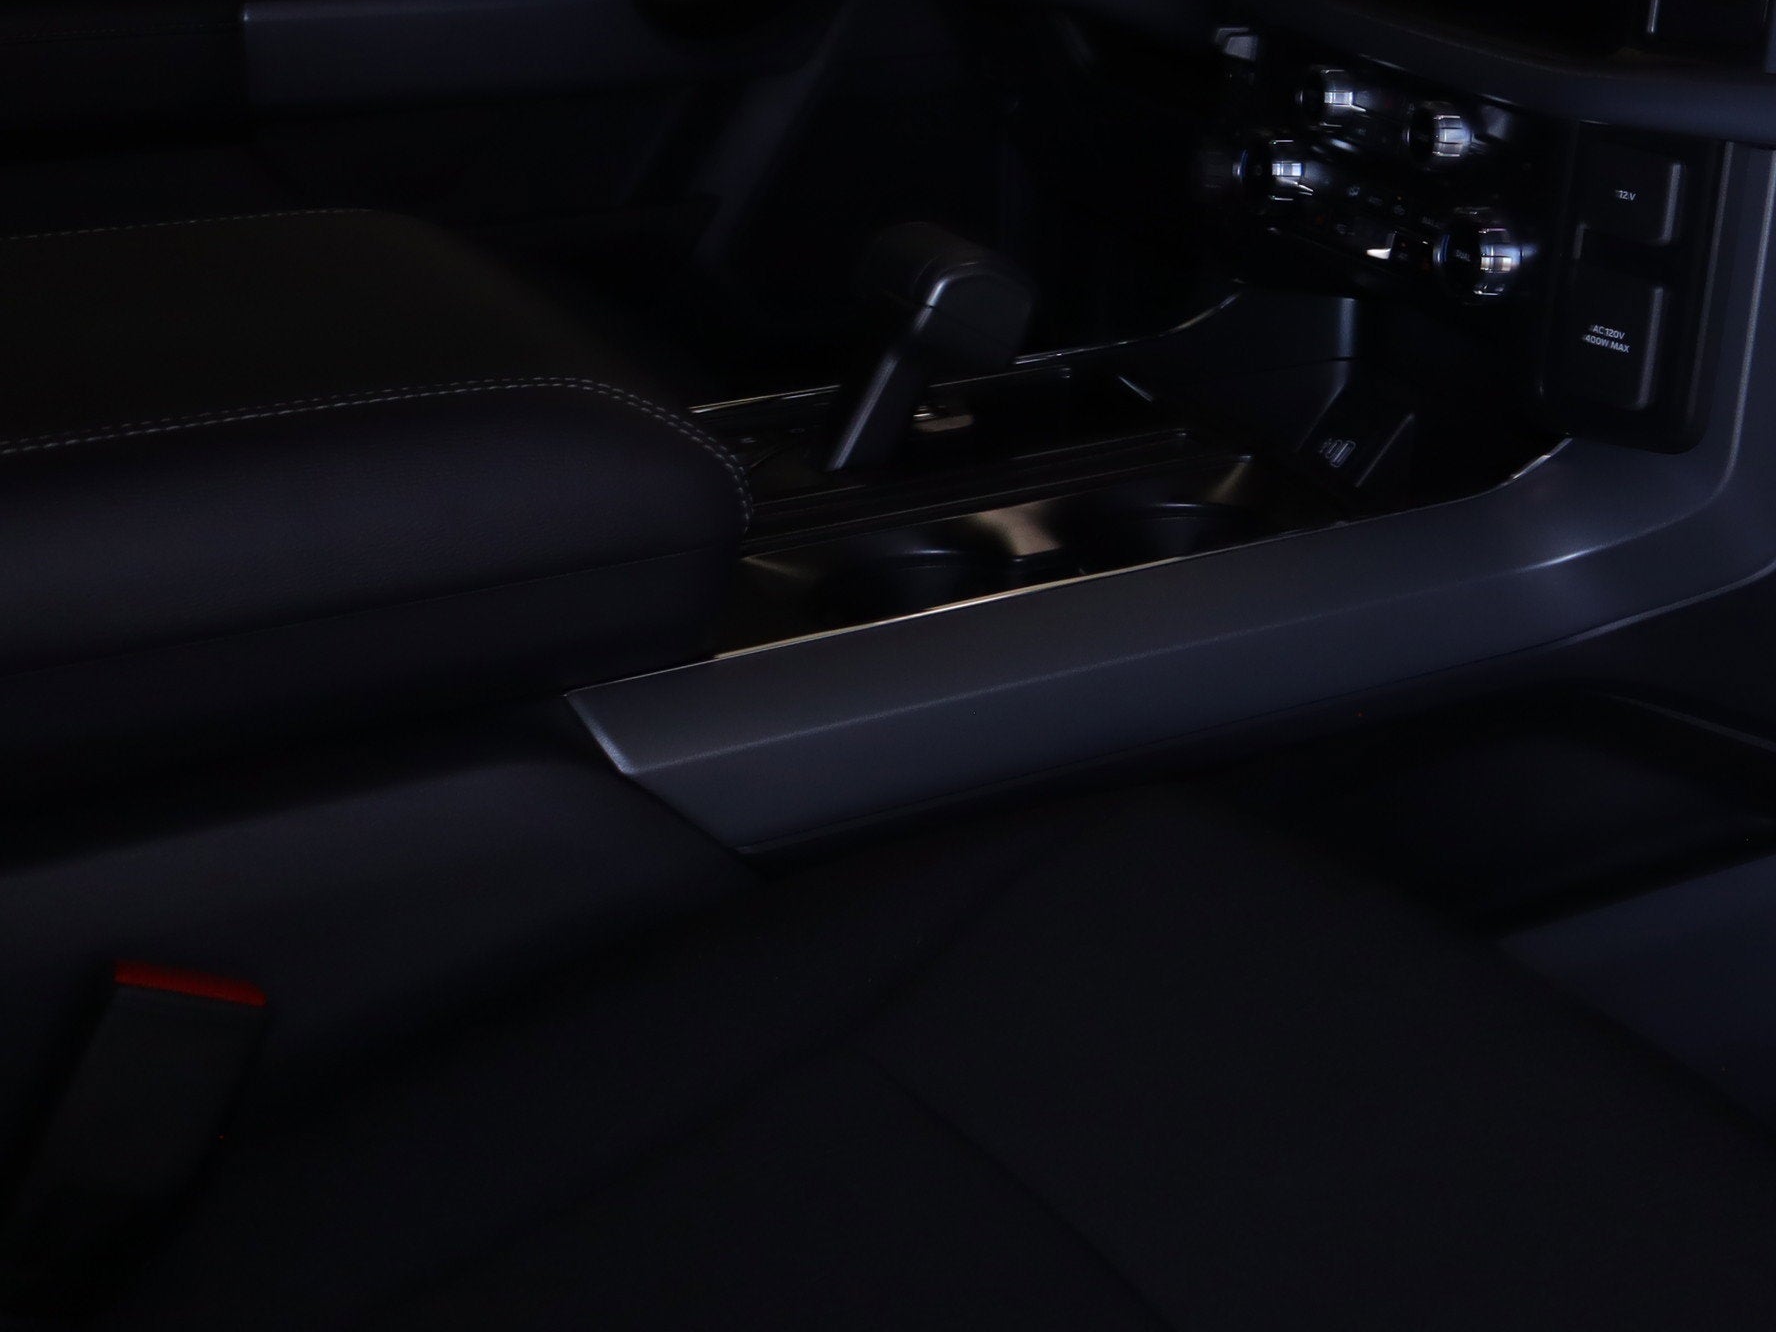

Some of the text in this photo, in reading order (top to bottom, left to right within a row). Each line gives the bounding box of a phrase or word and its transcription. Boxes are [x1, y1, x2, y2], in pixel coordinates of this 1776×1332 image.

[1592, 324, 1626, 340] AC 120V
[1584, 334, 1630, 353] 400W MAX
